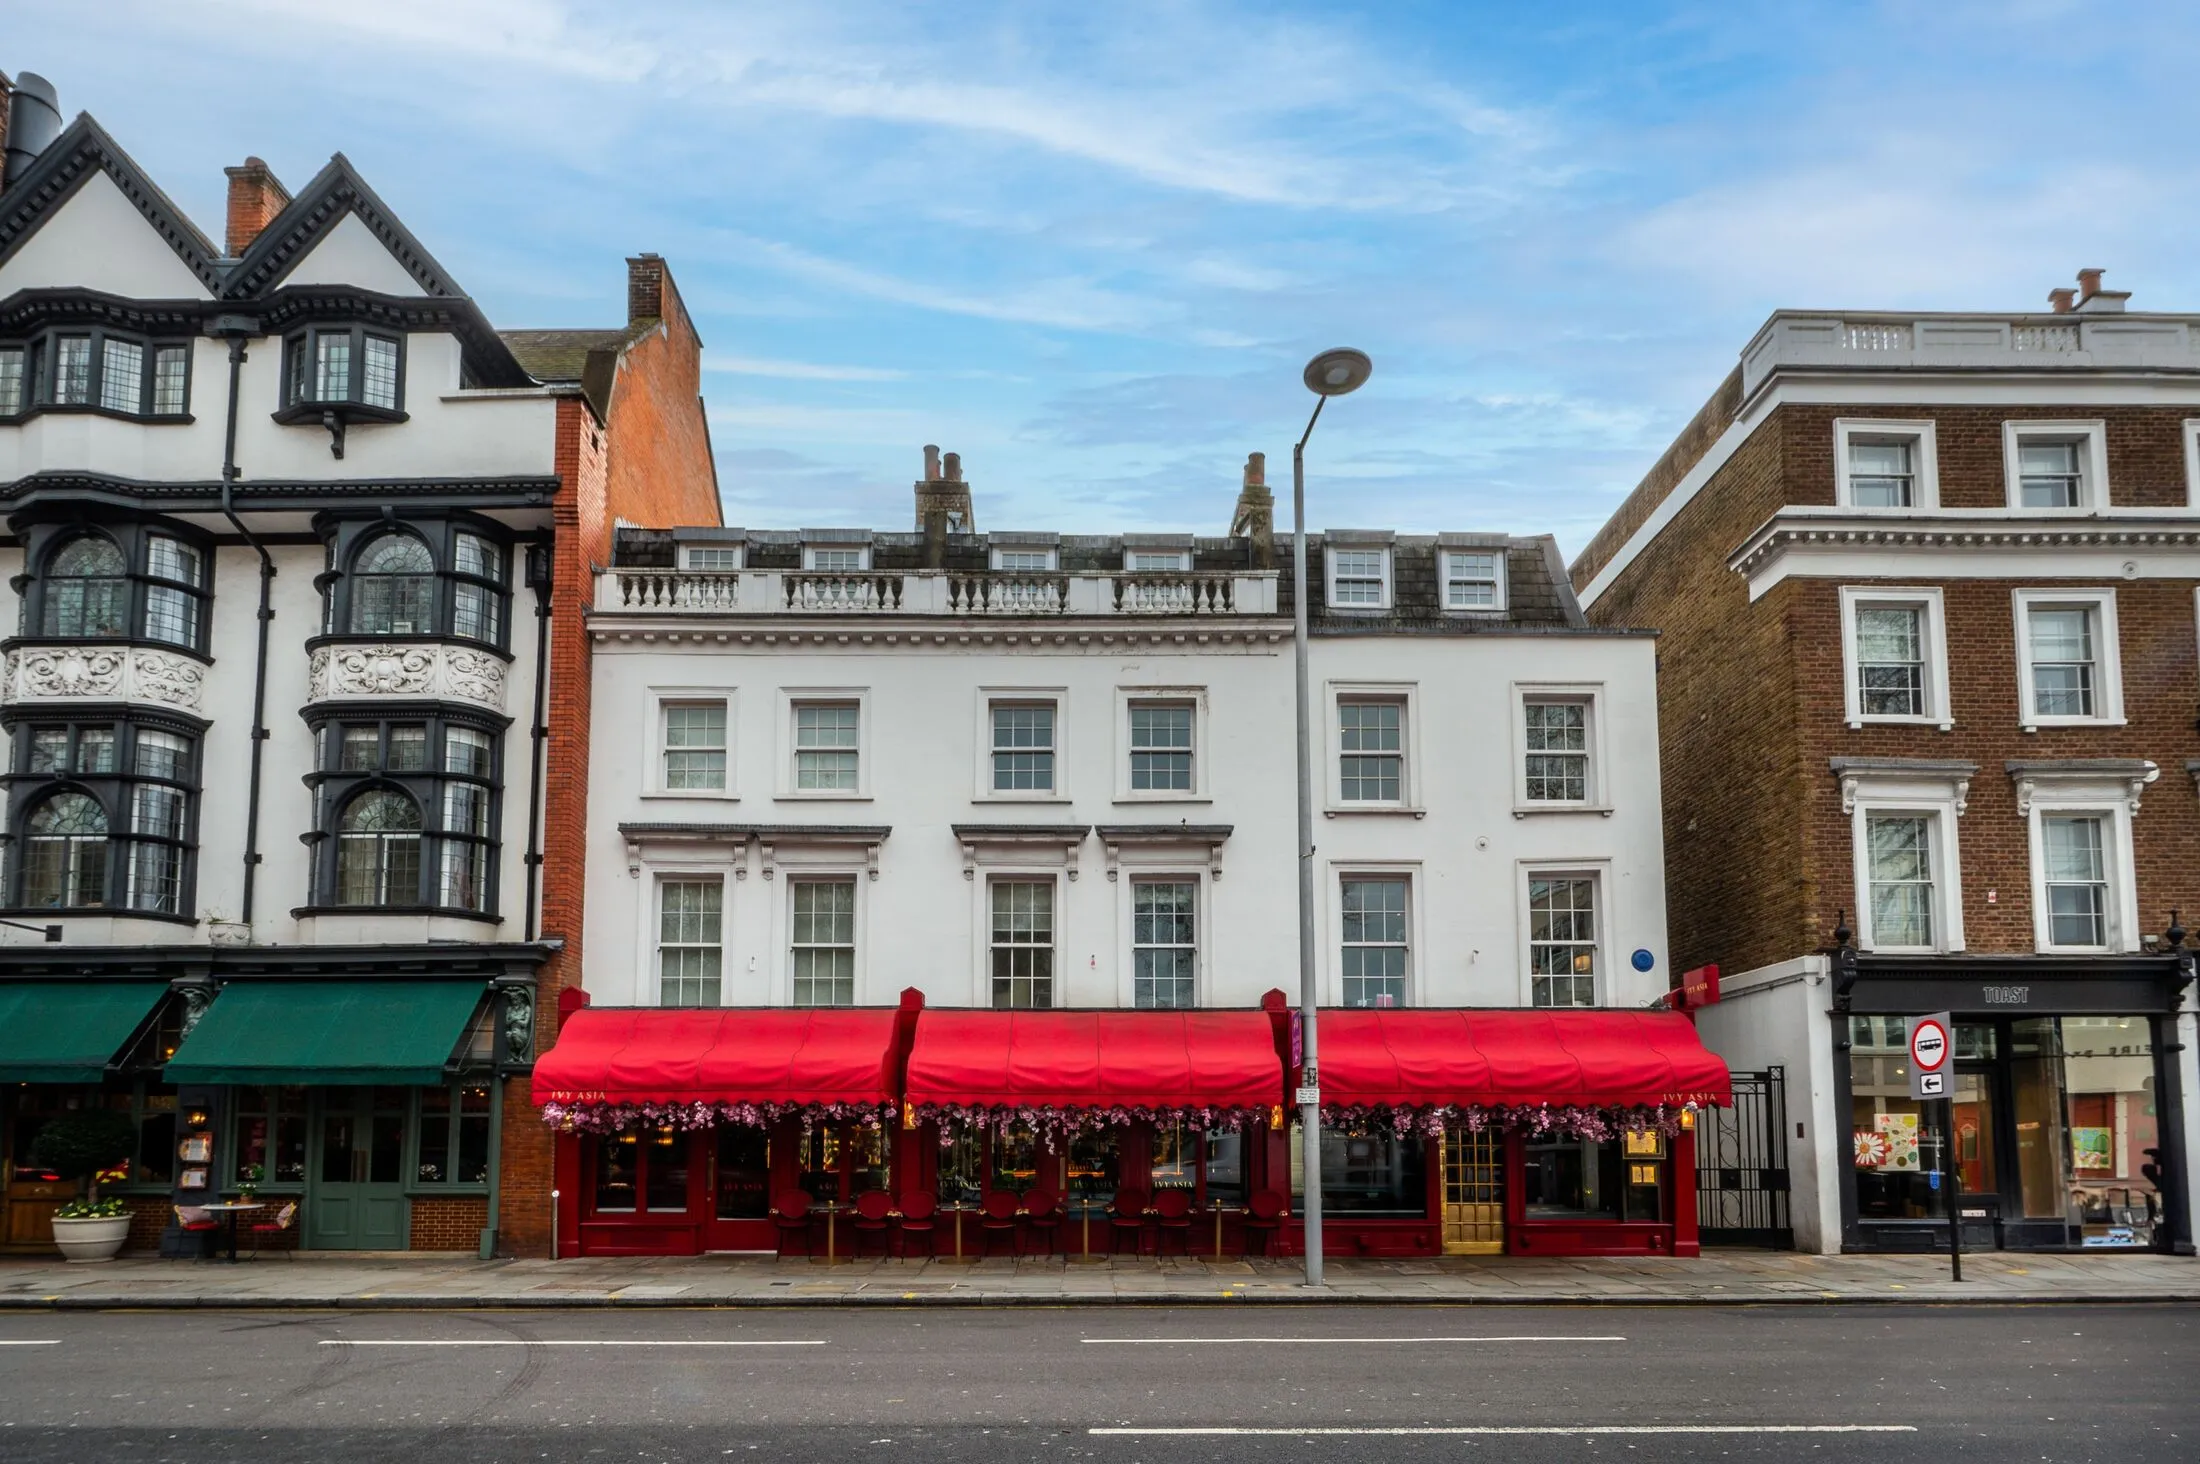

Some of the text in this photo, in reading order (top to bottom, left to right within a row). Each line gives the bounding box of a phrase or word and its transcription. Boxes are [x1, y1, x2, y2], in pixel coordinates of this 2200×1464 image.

[1983, 986, 2029, 1003] TOAST
[552, 1091, 605, 1100] IVY ASIA
[1663, 1093, 1716, 1102] IVY ASIA
